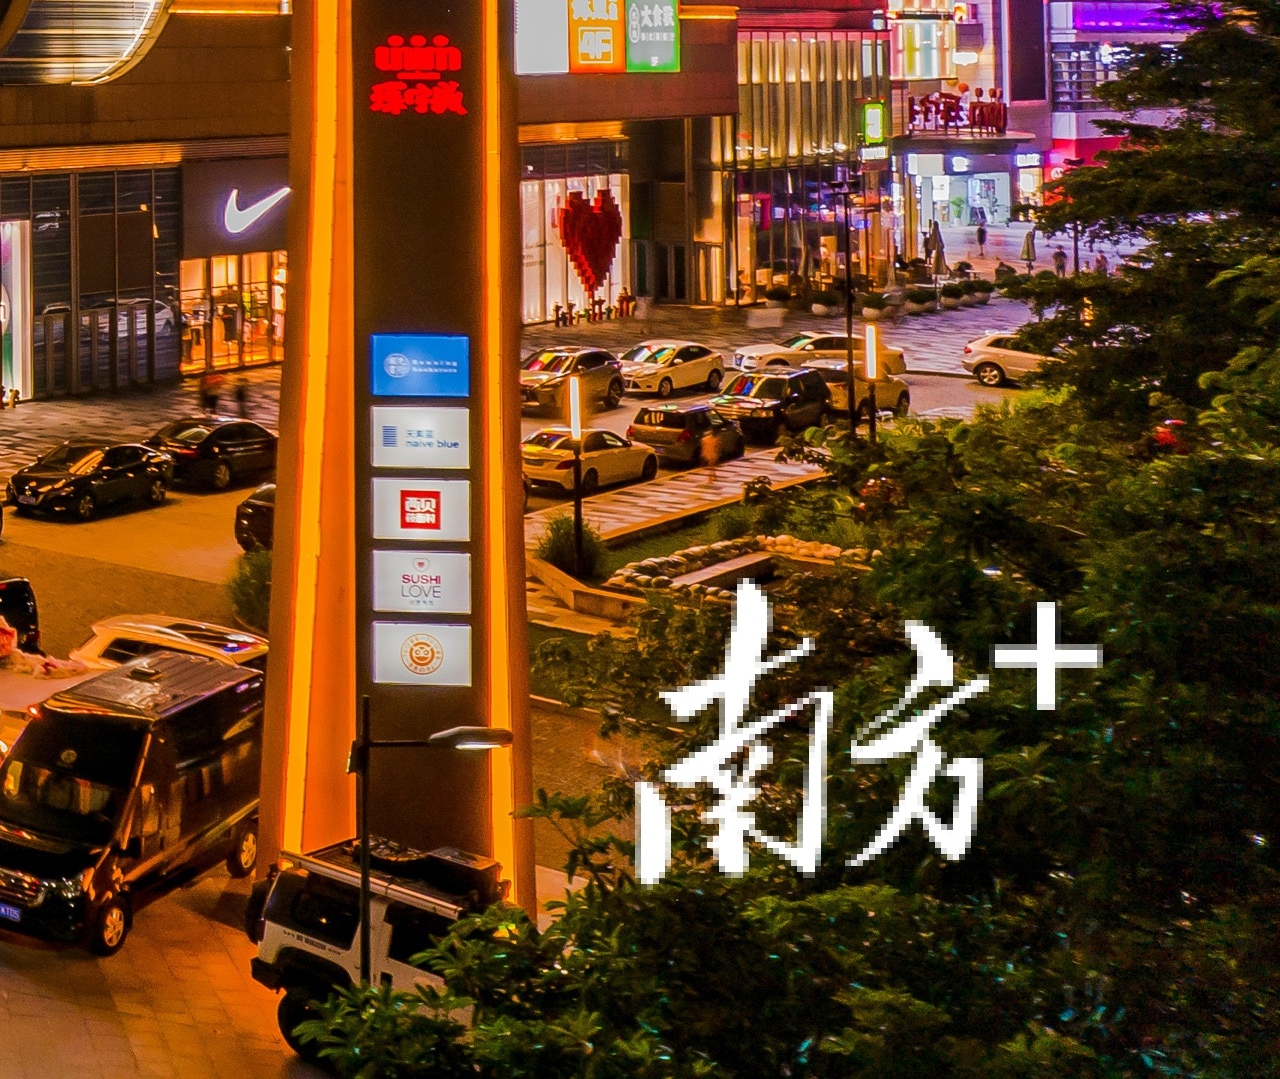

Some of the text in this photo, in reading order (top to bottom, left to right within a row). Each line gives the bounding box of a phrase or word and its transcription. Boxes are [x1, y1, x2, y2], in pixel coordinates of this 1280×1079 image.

[580, 31, 611, 59] 4F
[437, 440, 459, 448] blue
[405, 497, 436, 513] 西贝
[401, 574, 441, 585] SUSHI
[401, 585, 441, 598] LOVE
